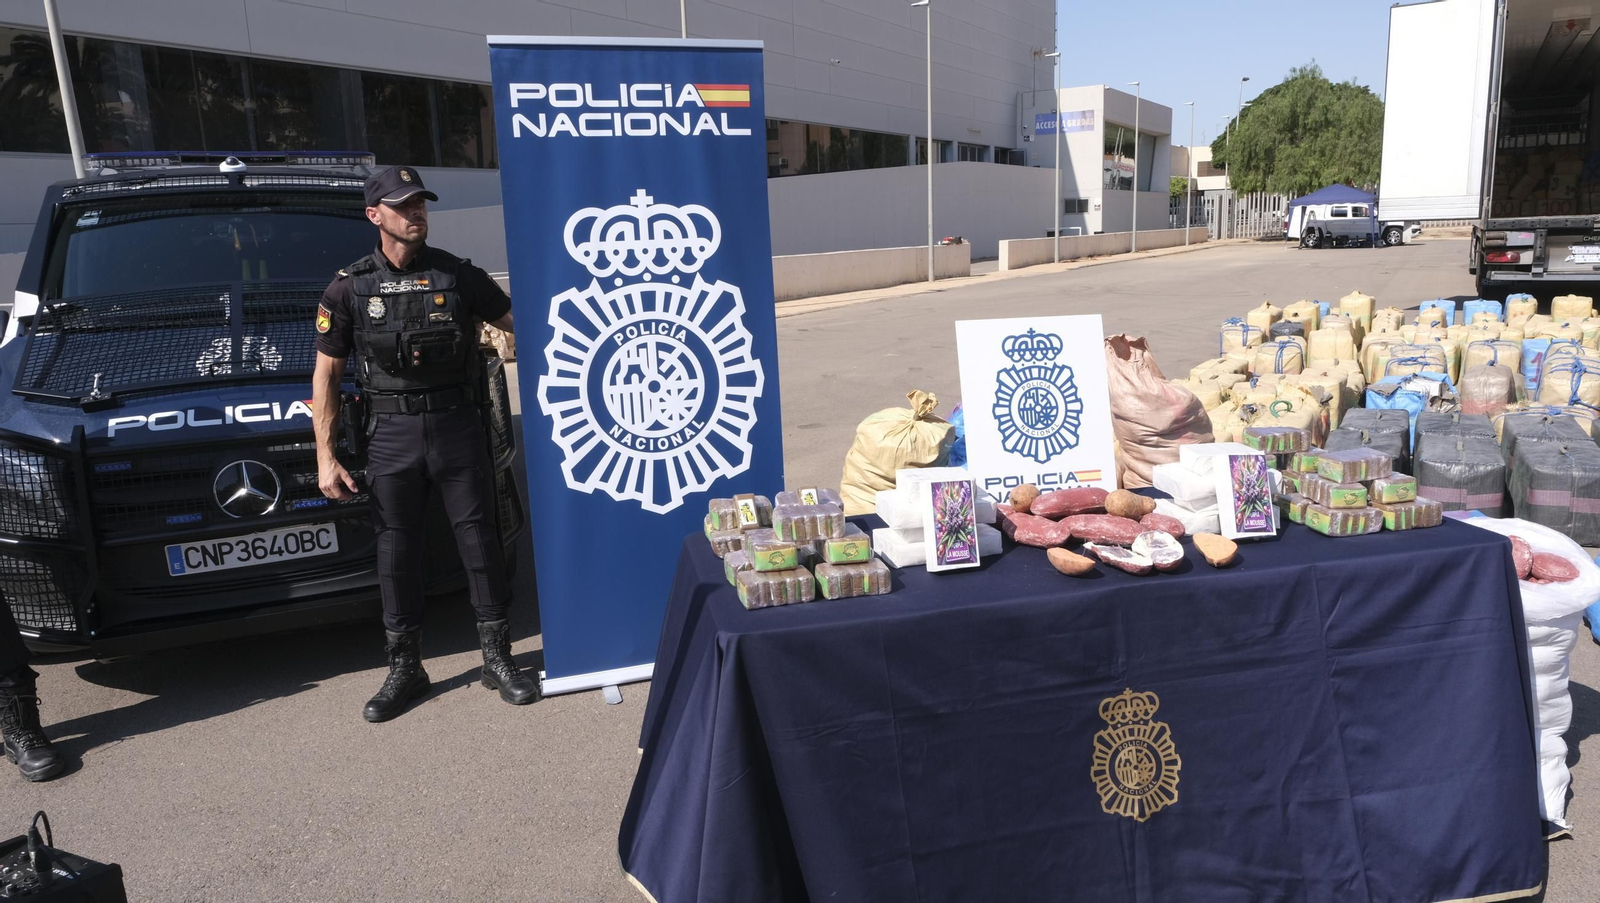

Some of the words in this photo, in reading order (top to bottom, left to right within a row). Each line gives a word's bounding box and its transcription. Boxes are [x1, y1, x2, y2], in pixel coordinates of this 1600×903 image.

[512, 112, 752, 138] NACIONAL
[1067, 117, 1094, 127] GRADAS
[380, 285, 430, 294] NACIONAL
[608, 420, 705, 451] NACIONAL
[1020, 423, 1060, 437] NACIONAL
[183, 527, 332, 570] CNP3640BC
[174, 562, 181, 570] E
[1118, 780, 1157, 795] NACIONAL
